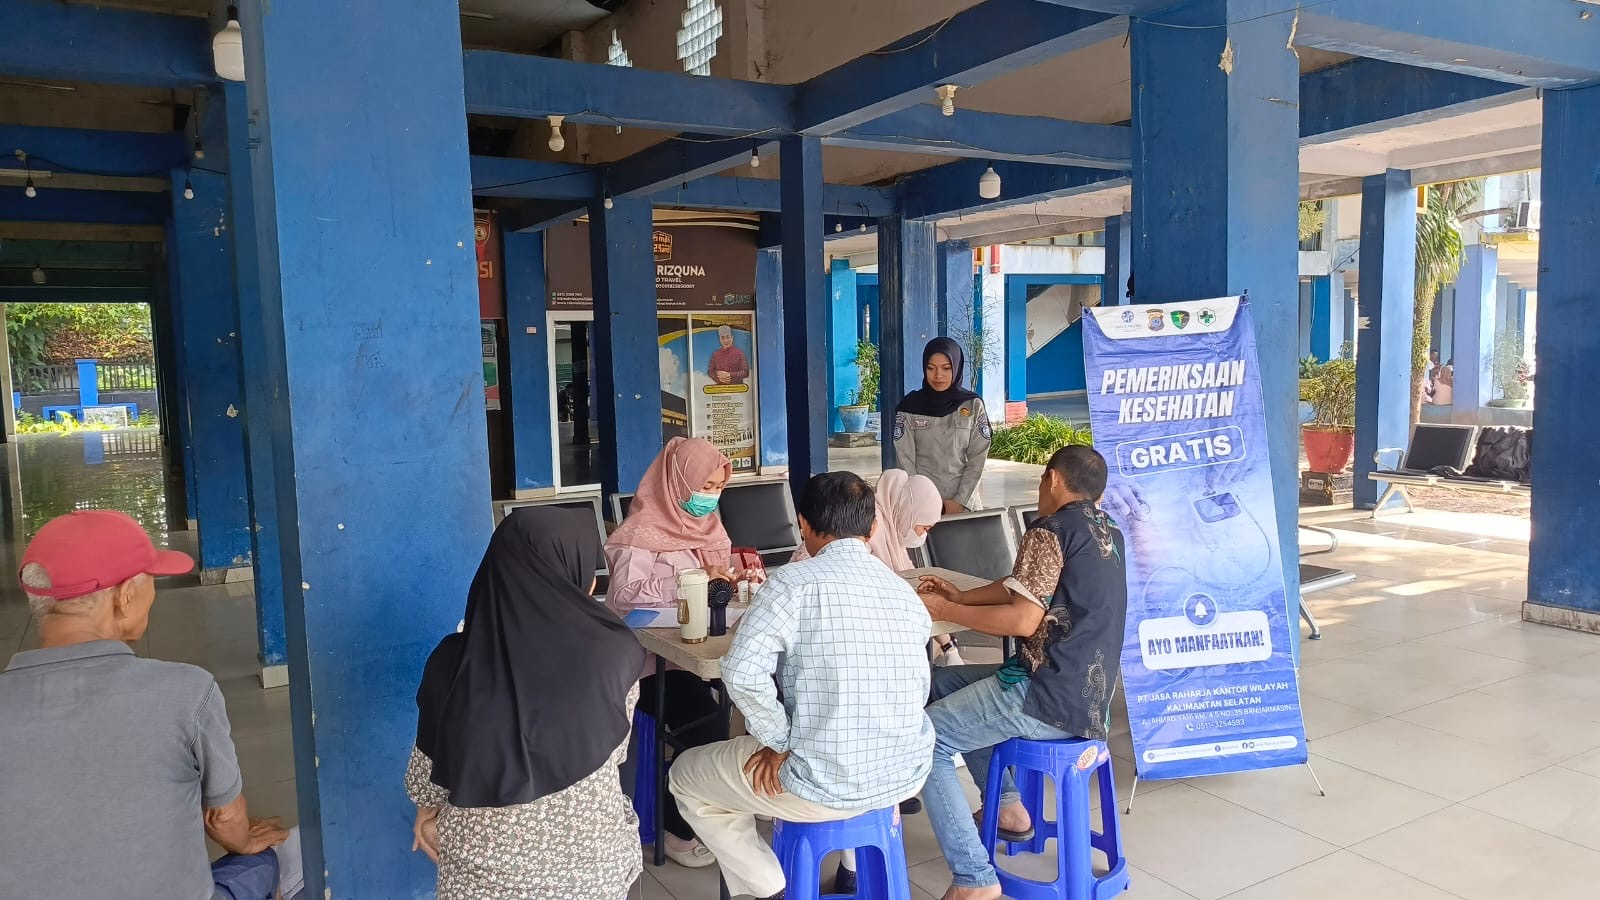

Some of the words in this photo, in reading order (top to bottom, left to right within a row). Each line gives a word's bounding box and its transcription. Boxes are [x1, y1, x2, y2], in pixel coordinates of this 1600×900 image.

[656, 264, 706, 277] RIZQUNA
[1101, 359, 1246, 396] PEMERIKSAAN
[1117, 391, 1235, 425] KESEHATAN
[1130, 434, 1232, 469] GRATIS
[1147, 637, 1172, 656] AYO
[1175, 629, 1265, 654] MANFAATKAN!
[1137, 694, 1148, 703] PT
[1150, 692, 1171, 702] JASA
[1172, 690, 1212, 700] RAHARJA
[1213, 686, 1248, 696] KANTOR
[1249, 681, 1289, 693] WILAYAH
[1151, 715, 1177, 724] AHMAD
[1233, 708, 1243, 716] 35
[1244, 704, 1292, 715] BANJARMASIN
[1166, 701, 1223, 713] KALIMANTAN
[1224, 696, 1262, 707] SELATAN
